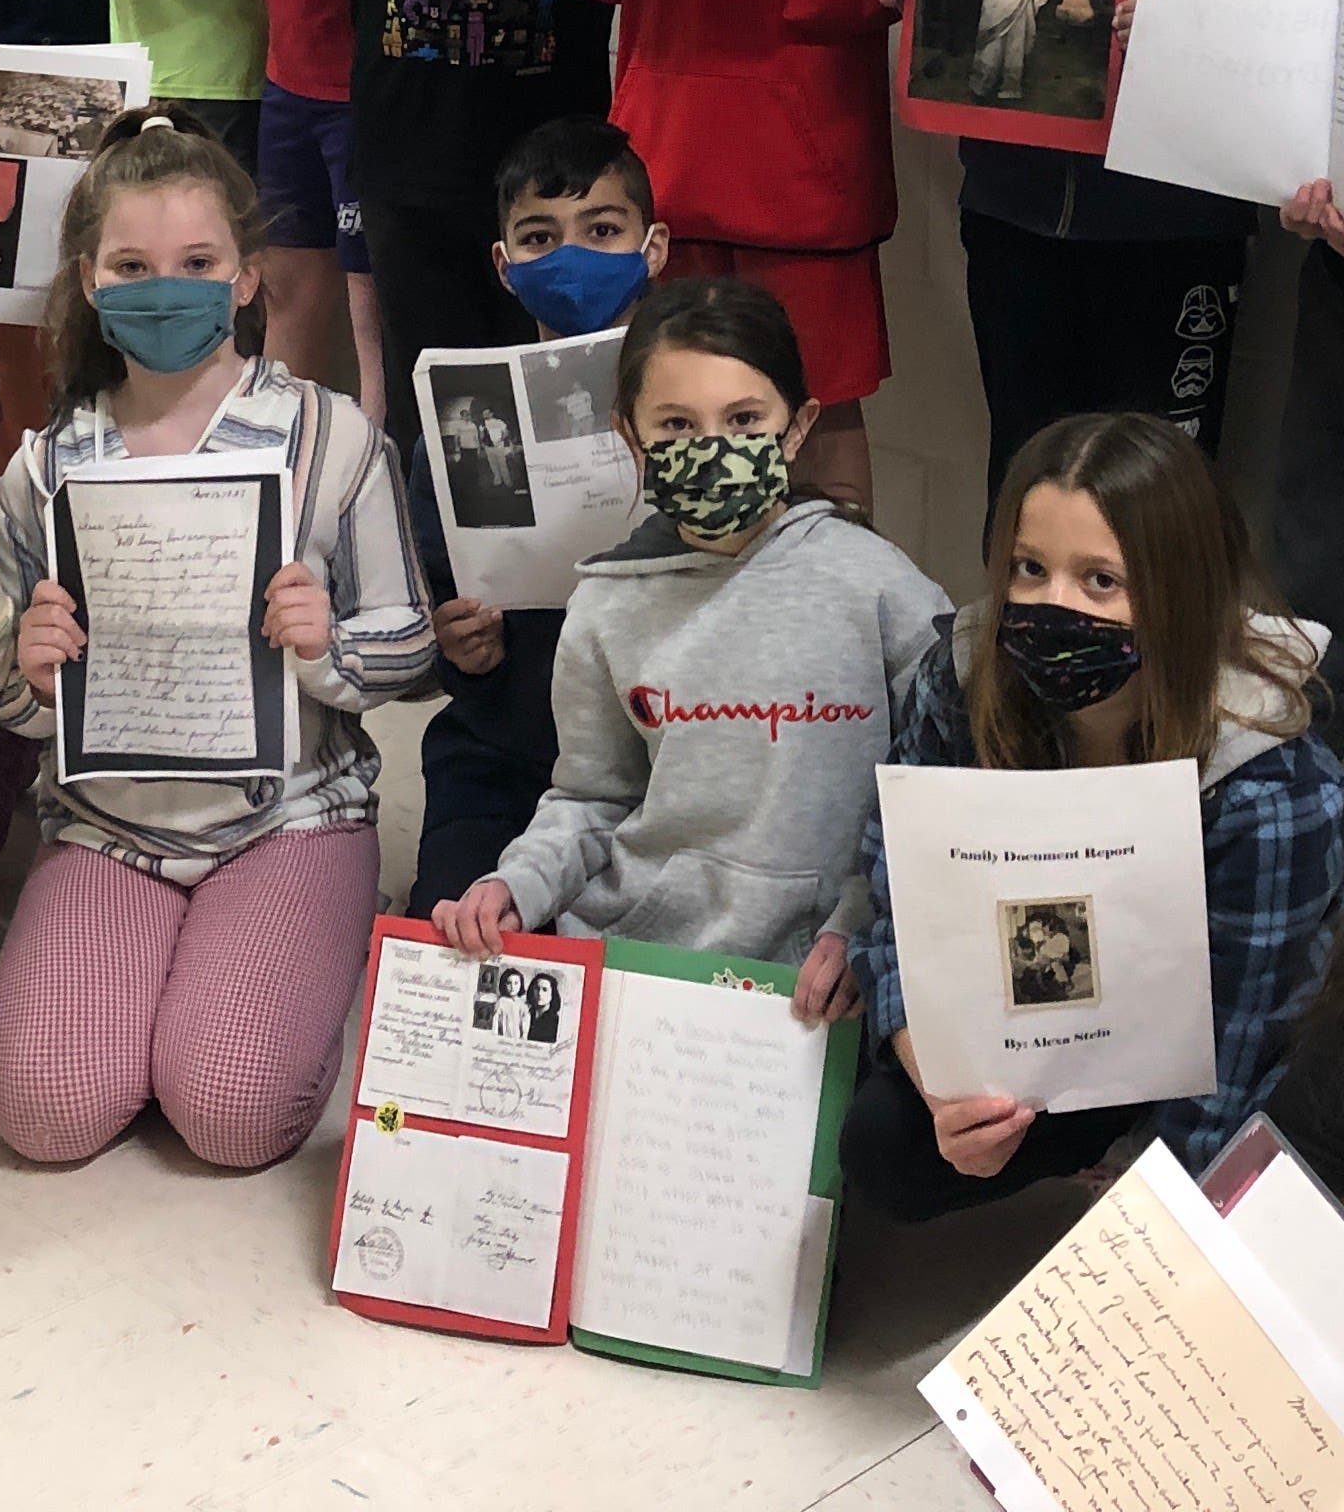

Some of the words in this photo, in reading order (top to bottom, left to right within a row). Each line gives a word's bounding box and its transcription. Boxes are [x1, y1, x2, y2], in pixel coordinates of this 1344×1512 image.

[629, 685, 874, 743] Champion
[950, 847, 998, 864] Family
[1004, 848, 1079, 862] Document
[1085, 844, 1135, 861] Report
[1004, 1038, 1028, 1052] By:
[1032, 1035, 1070, 1049] Alexa
[1074, 1028, 1111, 1042] Stein
[1106, 1190, 1134, 1226] Dear
